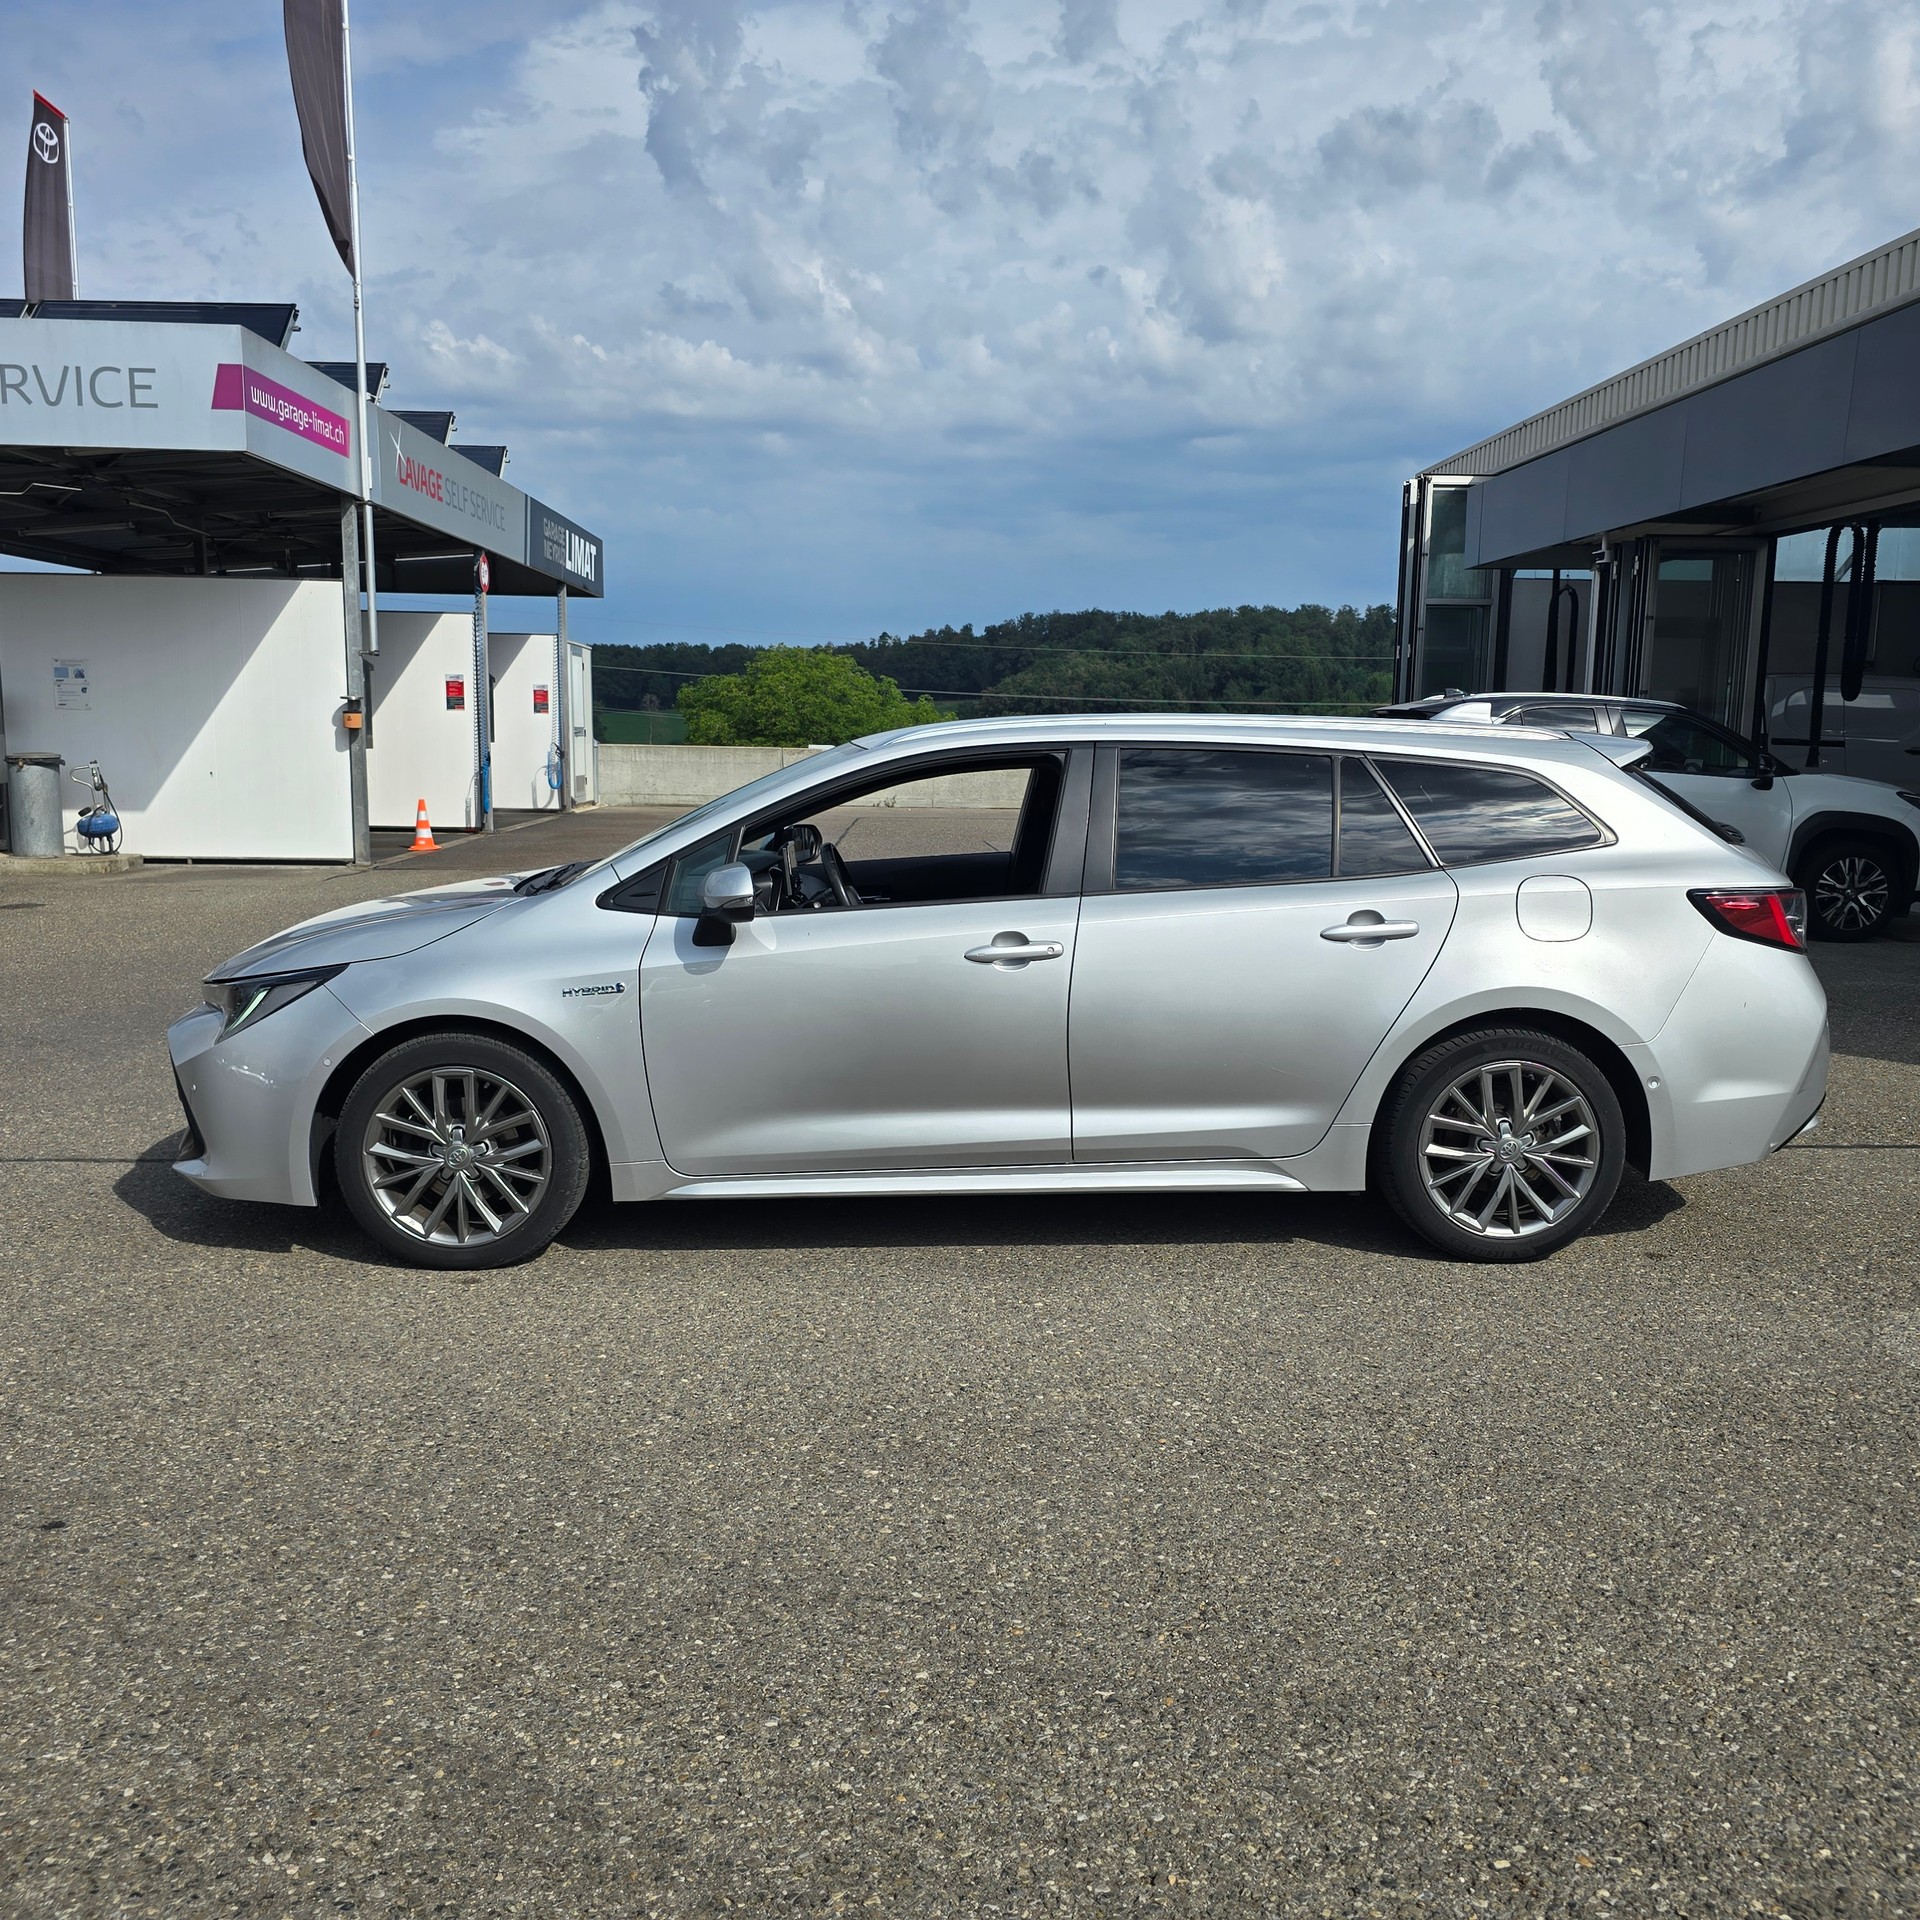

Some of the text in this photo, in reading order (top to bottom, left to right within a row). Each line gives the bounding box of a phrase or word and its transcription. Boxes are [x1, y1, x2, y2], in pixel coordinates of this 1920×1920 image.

[250, 385, 345, 446] www.garage-limat.ch
[397, 453, 506, 532] LAVAGE SELF SERVICE
[543, 517, 566, 546] GARAGE
[565, 529, 597, 582] LIMAT
[562, 985, 615, 998] HYBRID
